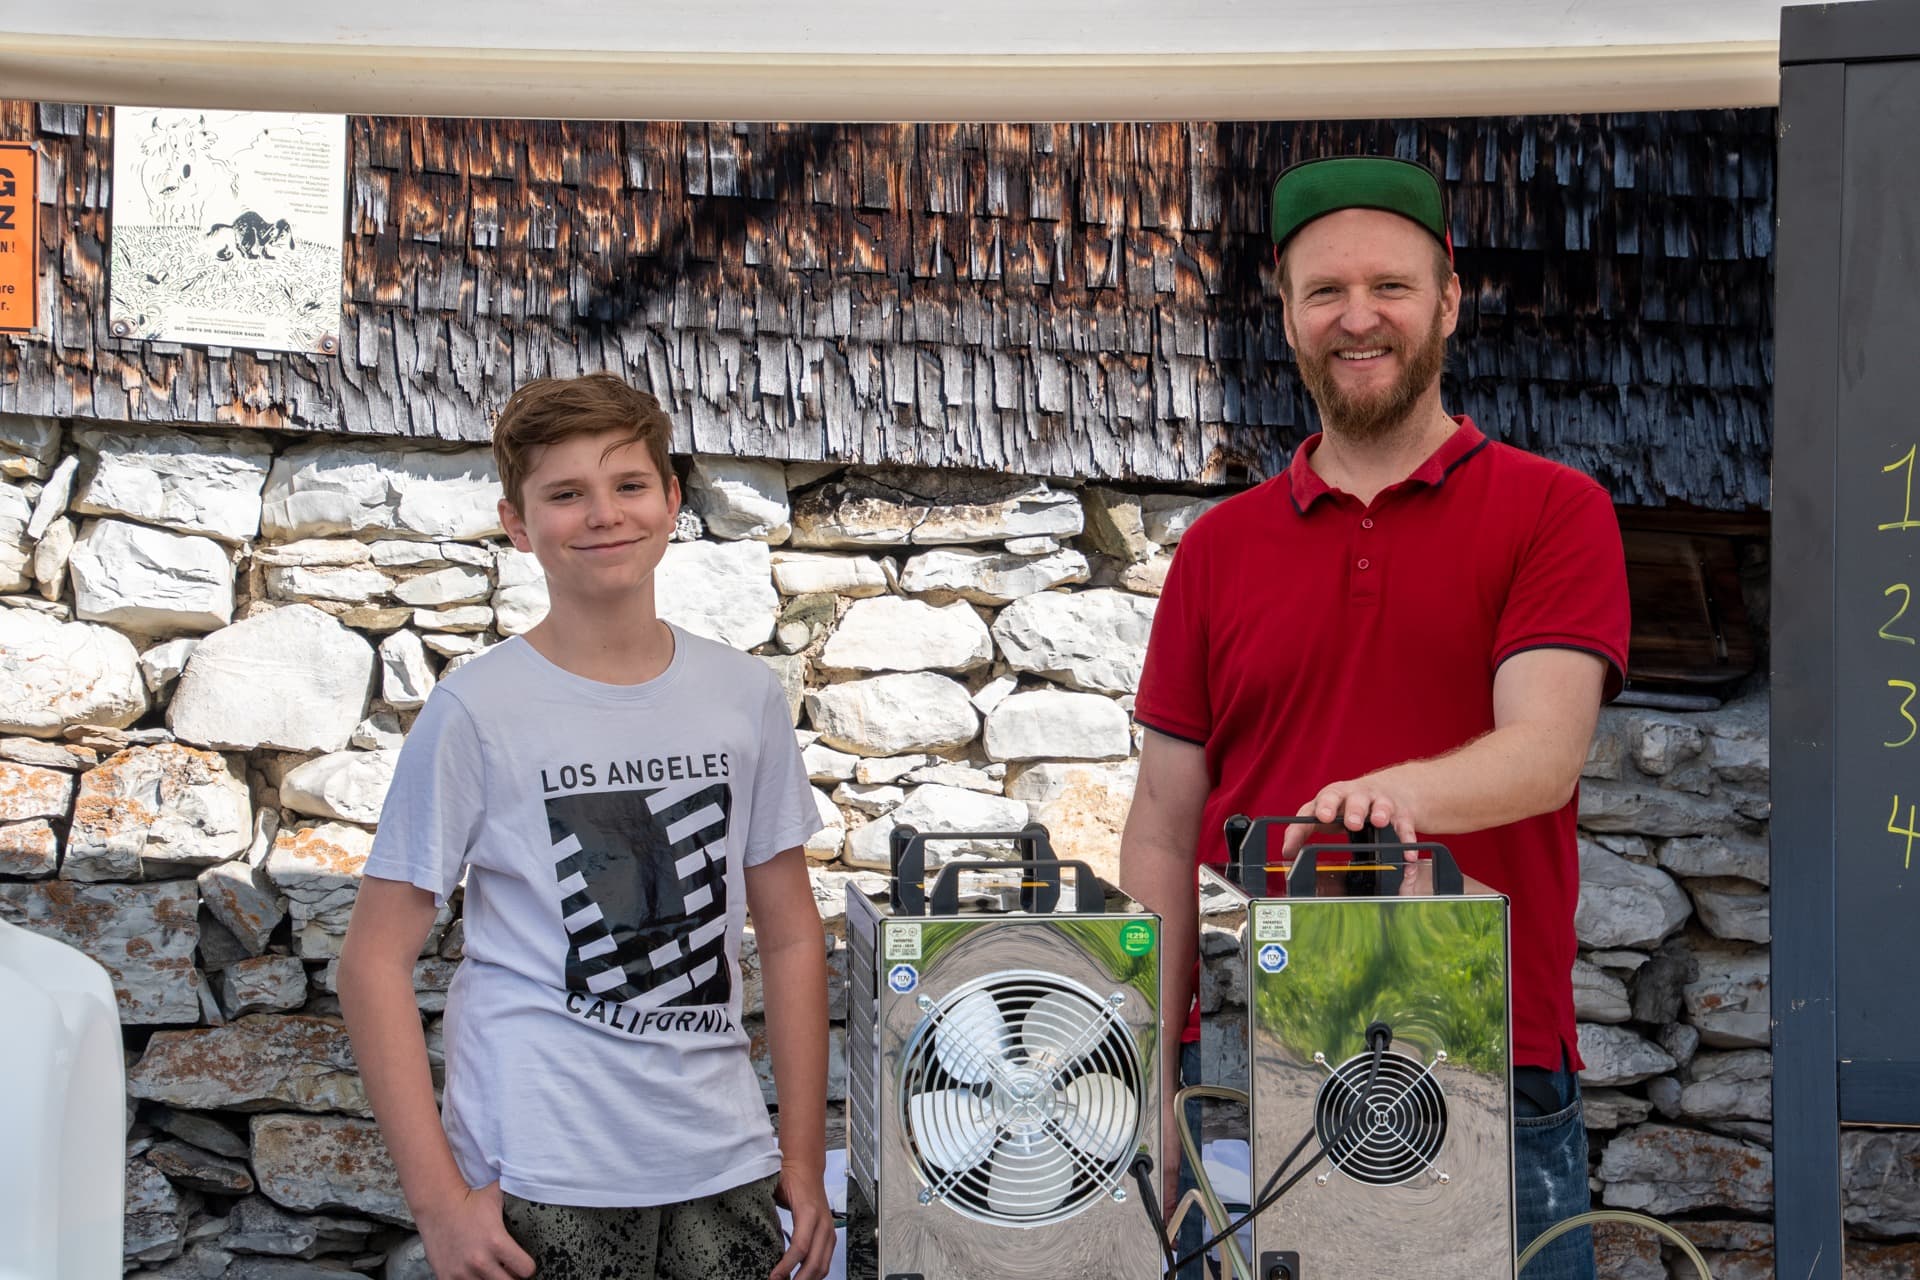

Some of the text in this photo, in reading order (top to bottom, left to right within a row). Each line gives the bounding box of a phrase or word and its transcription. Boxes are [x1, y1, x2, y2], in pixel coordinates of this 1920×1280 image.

[0, 284, 15, 294] re
[1878, 443, 1920, 531] 1
[1879, 584, 1915, 644] 2
[1884, 679, 1917, 747] 3
[541, 753, 729, 793] LOS ANGELES
[1888, 795, 1920, 868] 4
[566, 992, 736, 1034] CALIFORNIA
